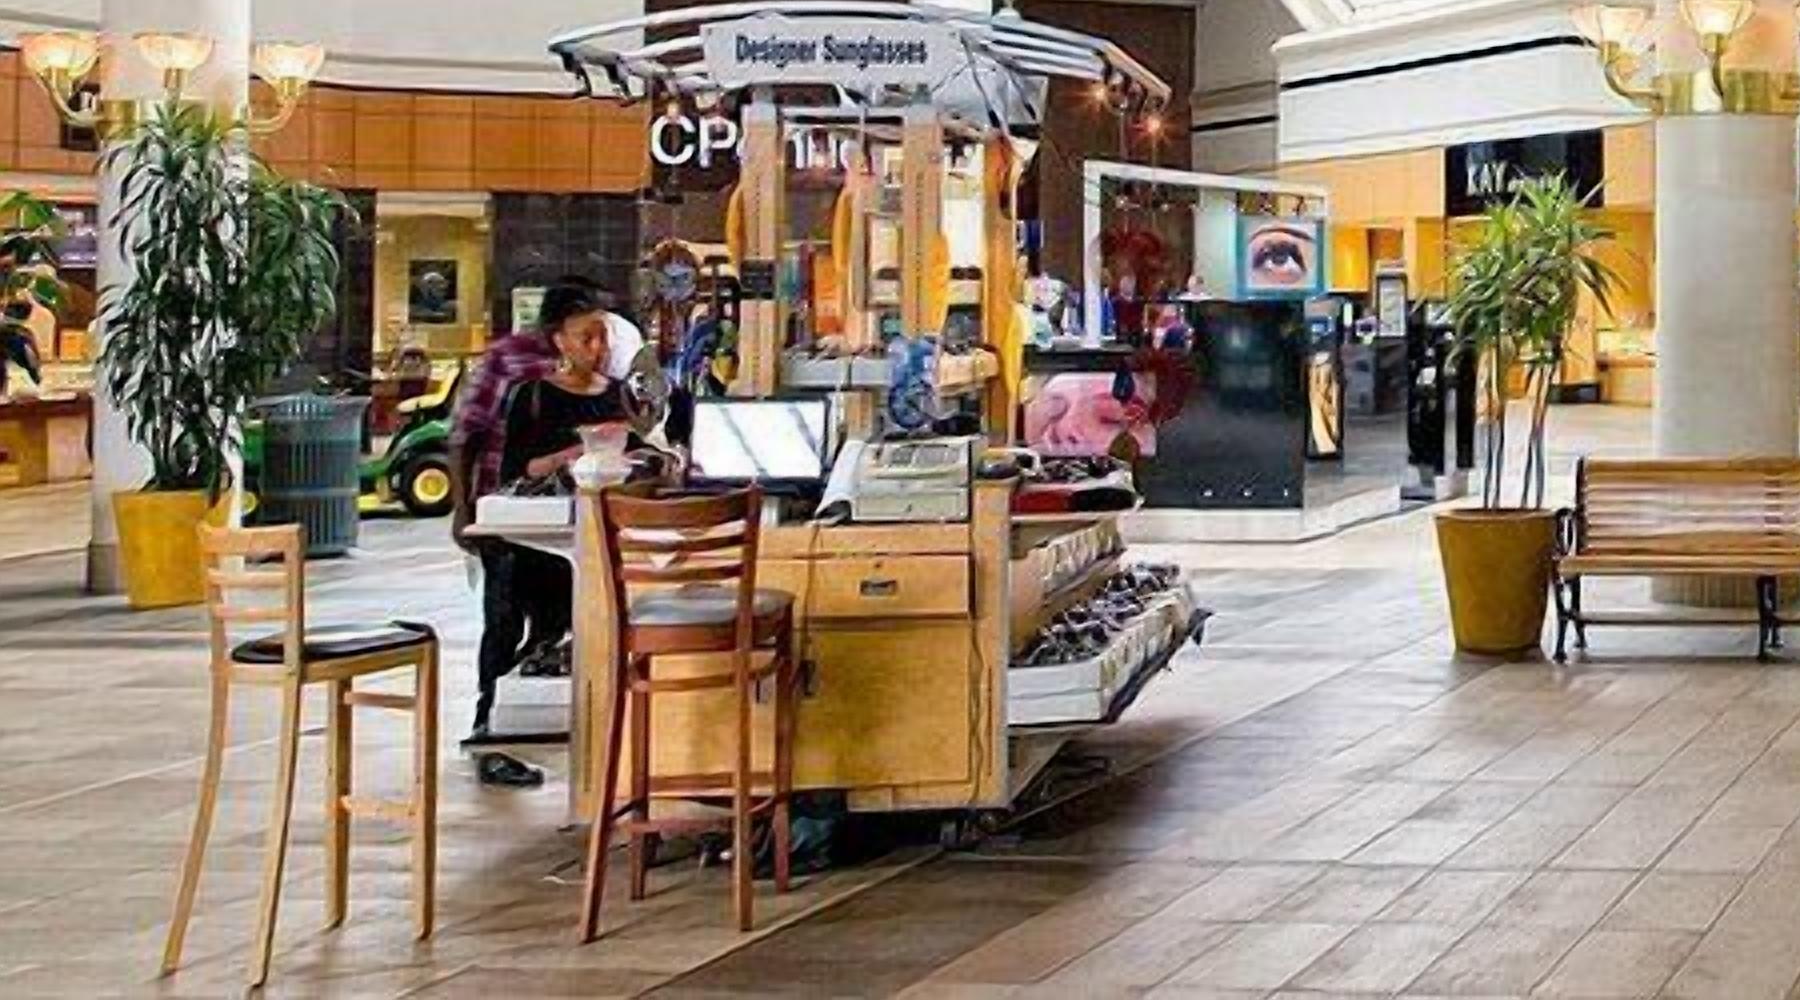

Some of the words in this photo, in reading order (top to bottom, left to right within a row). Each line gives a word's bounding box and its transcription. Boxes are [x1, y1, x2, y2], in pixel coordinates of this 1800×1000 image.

[736, 33, 816, 70] Designer
[823, 33, 928, 72] Sunglasses
[1466, 157, 1508, 196] KAY
